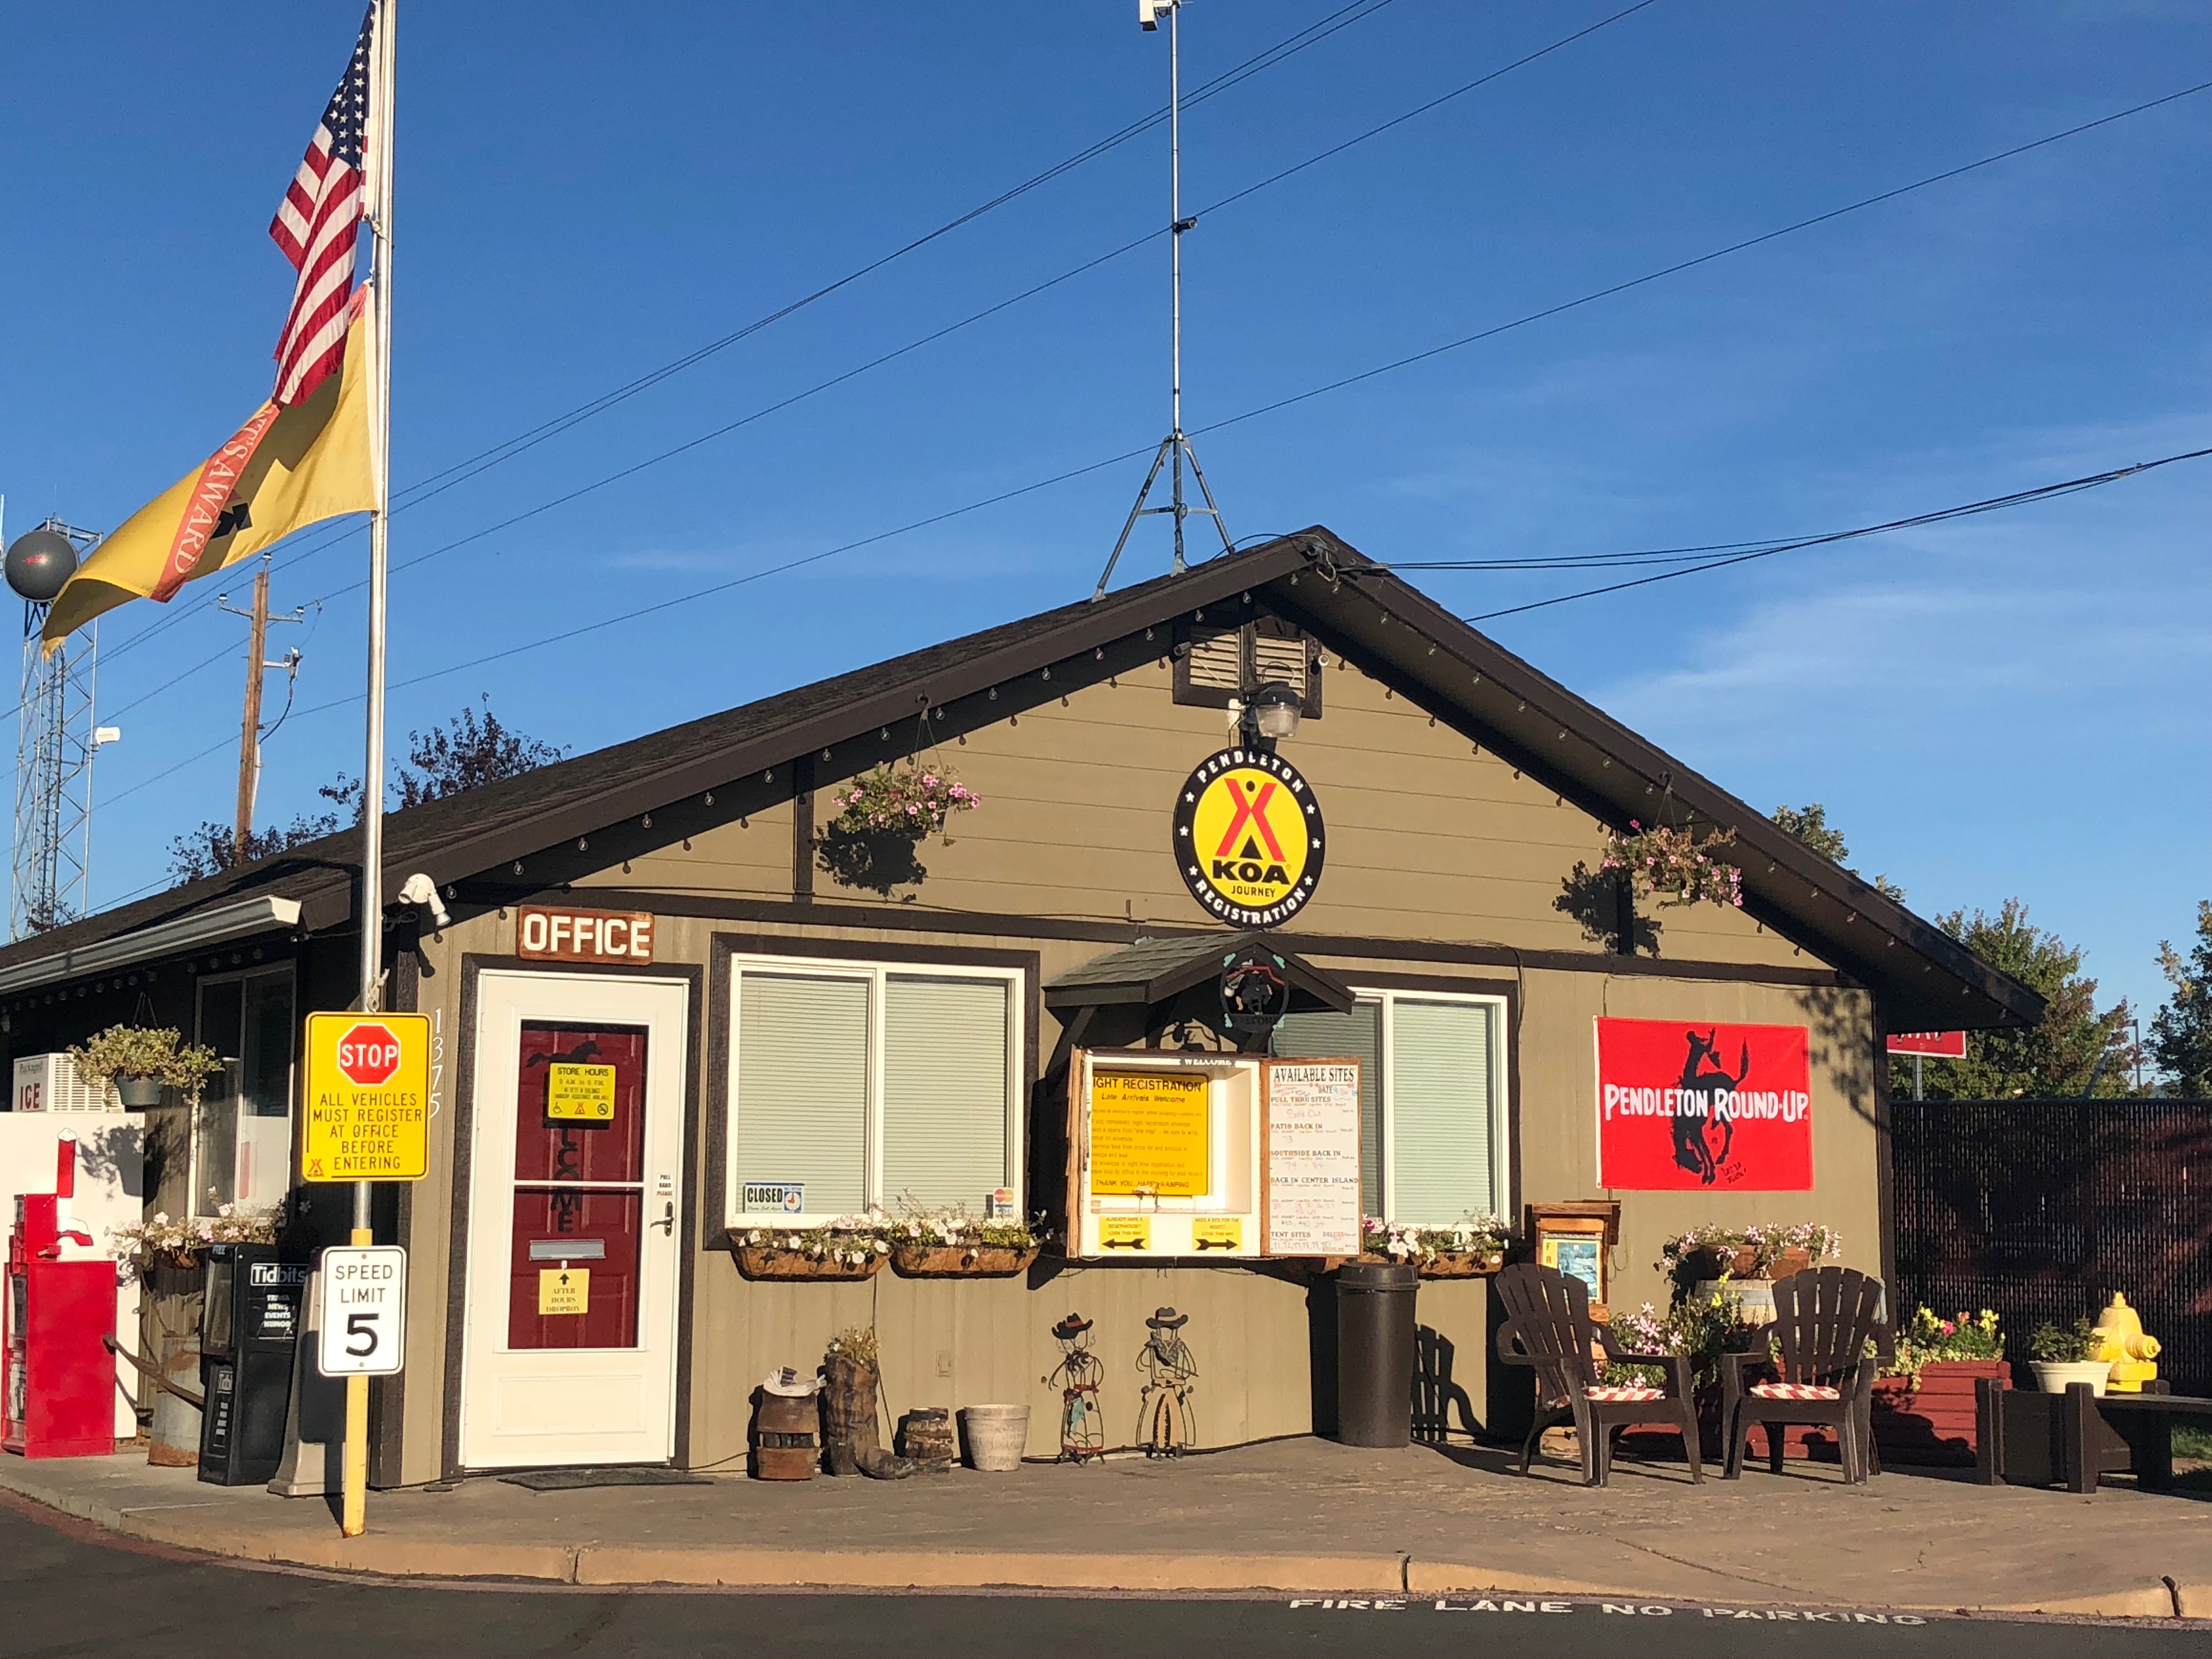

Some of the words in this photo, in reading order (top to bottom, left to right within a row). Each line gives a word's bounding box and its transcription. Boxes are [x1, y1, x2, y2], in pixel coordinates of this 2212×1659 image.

[175, 459, 235, 574] AWARD
[1197, 751, 1305, 793] PENDLETON
[1212, 859, 1291, 885] KOA
[1231, 885, 1276, 898] JOURNEY
[1195, 879, 1306, 924] REGISTRATION
[524, 913, 651, 957] OFFICE
[341, 1044, 398, 1067] STOP
[430, 1008, 443, 1119] 1375
[557, 1067, 580, 1075] STORE
[1273, 1068, 1327, 1082] AVAILABLE
[1329, 1068, 1354, 1082] SITES
[1093, 1077, 1119, 1088] IGHT
[1122, 1079, 1201, 1092] REGISTRATION
[20, 1082, 40, 1110] ICE
[320, 1093, 343, 1106] ALL
[352, 1093, 417, 1106] VEHICLES
[1121, 1093, 1149, 1102] Arrivals
[1604, 1084, 1708, 1120] PENDLETON
[313, 1109, 349, 1122] MUST
[358, 1109, 422, 1122] REGISTER
[330, 1125, 345, 1137] AT
[353, 1125, 399, 1138] OFFICE
[342, 1141, 394, 1153] BEFORE
[334, 1156, 400, 1170] ENTERING
[550, 1127, 582, 1233] LCOME
[747, 1187, 783, 1203] CLOSED
[252, 1266, 306, 1283] Tidbits
[335, 1265, 393, 1280] SPEED
[341, 1288, 386, 1304] LIMIT
[346, 1313, 379, 1357] 5
[1289, 1599, 1406, 1610] FIRE
[1435, 1600, 1573, 1613] LANE
[1602, 1604, 1673, 1616] NO
[1702, 1607, 1927, 1625] PARKING
